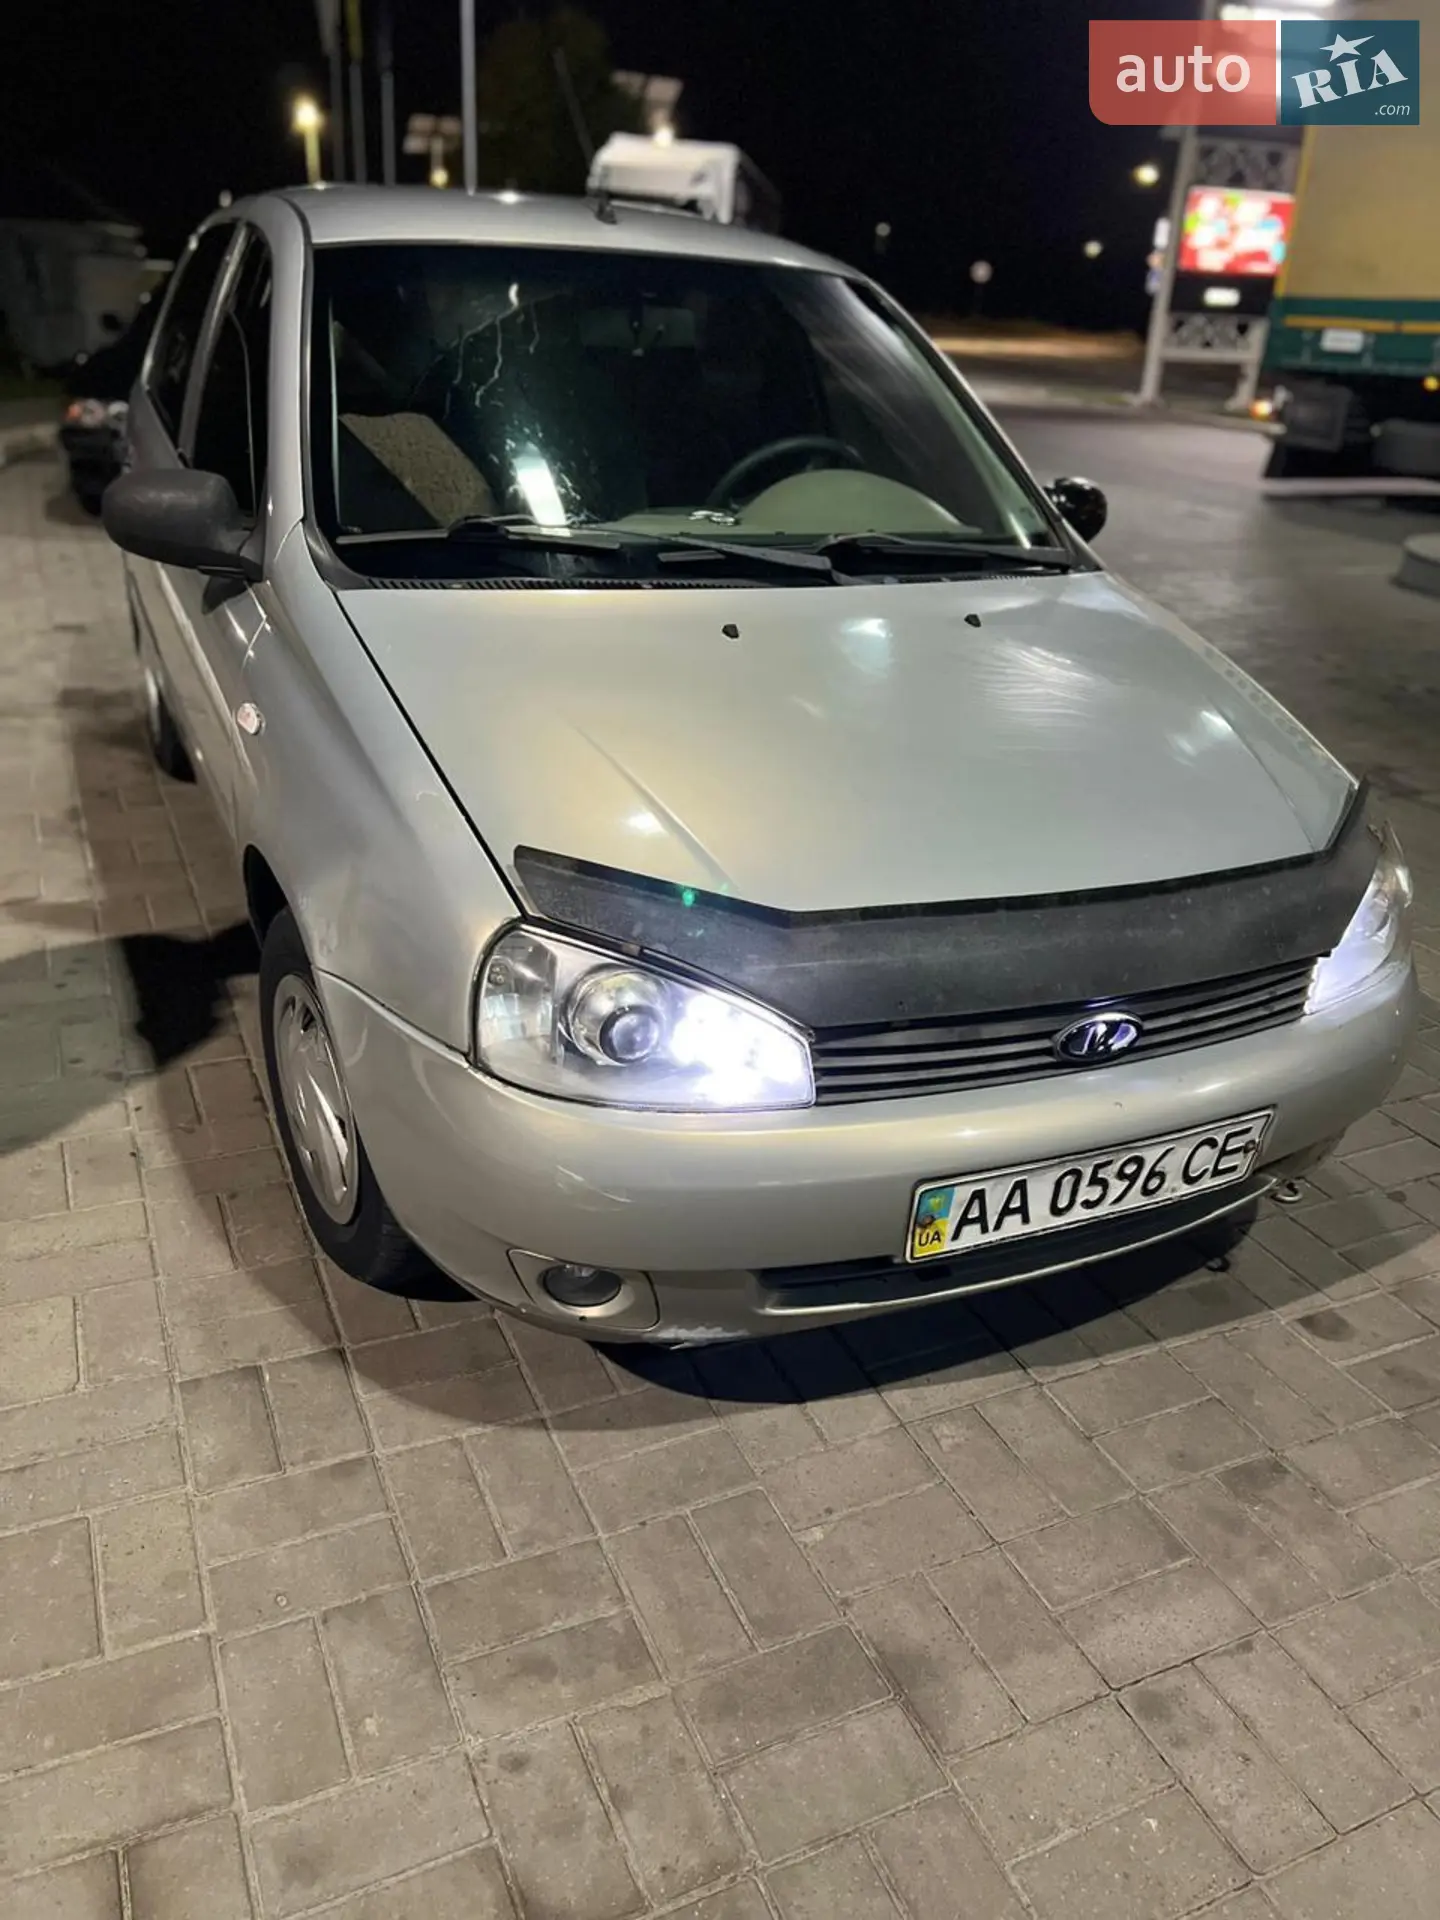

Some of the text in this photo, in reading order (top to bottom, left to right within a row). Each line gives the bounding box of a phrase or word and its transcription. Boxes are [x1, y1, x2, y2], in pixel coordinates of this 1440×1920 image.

[951, 1126, 1253, 1241] AA 0596 CE
[917, 1229, 943, 1248] UA
